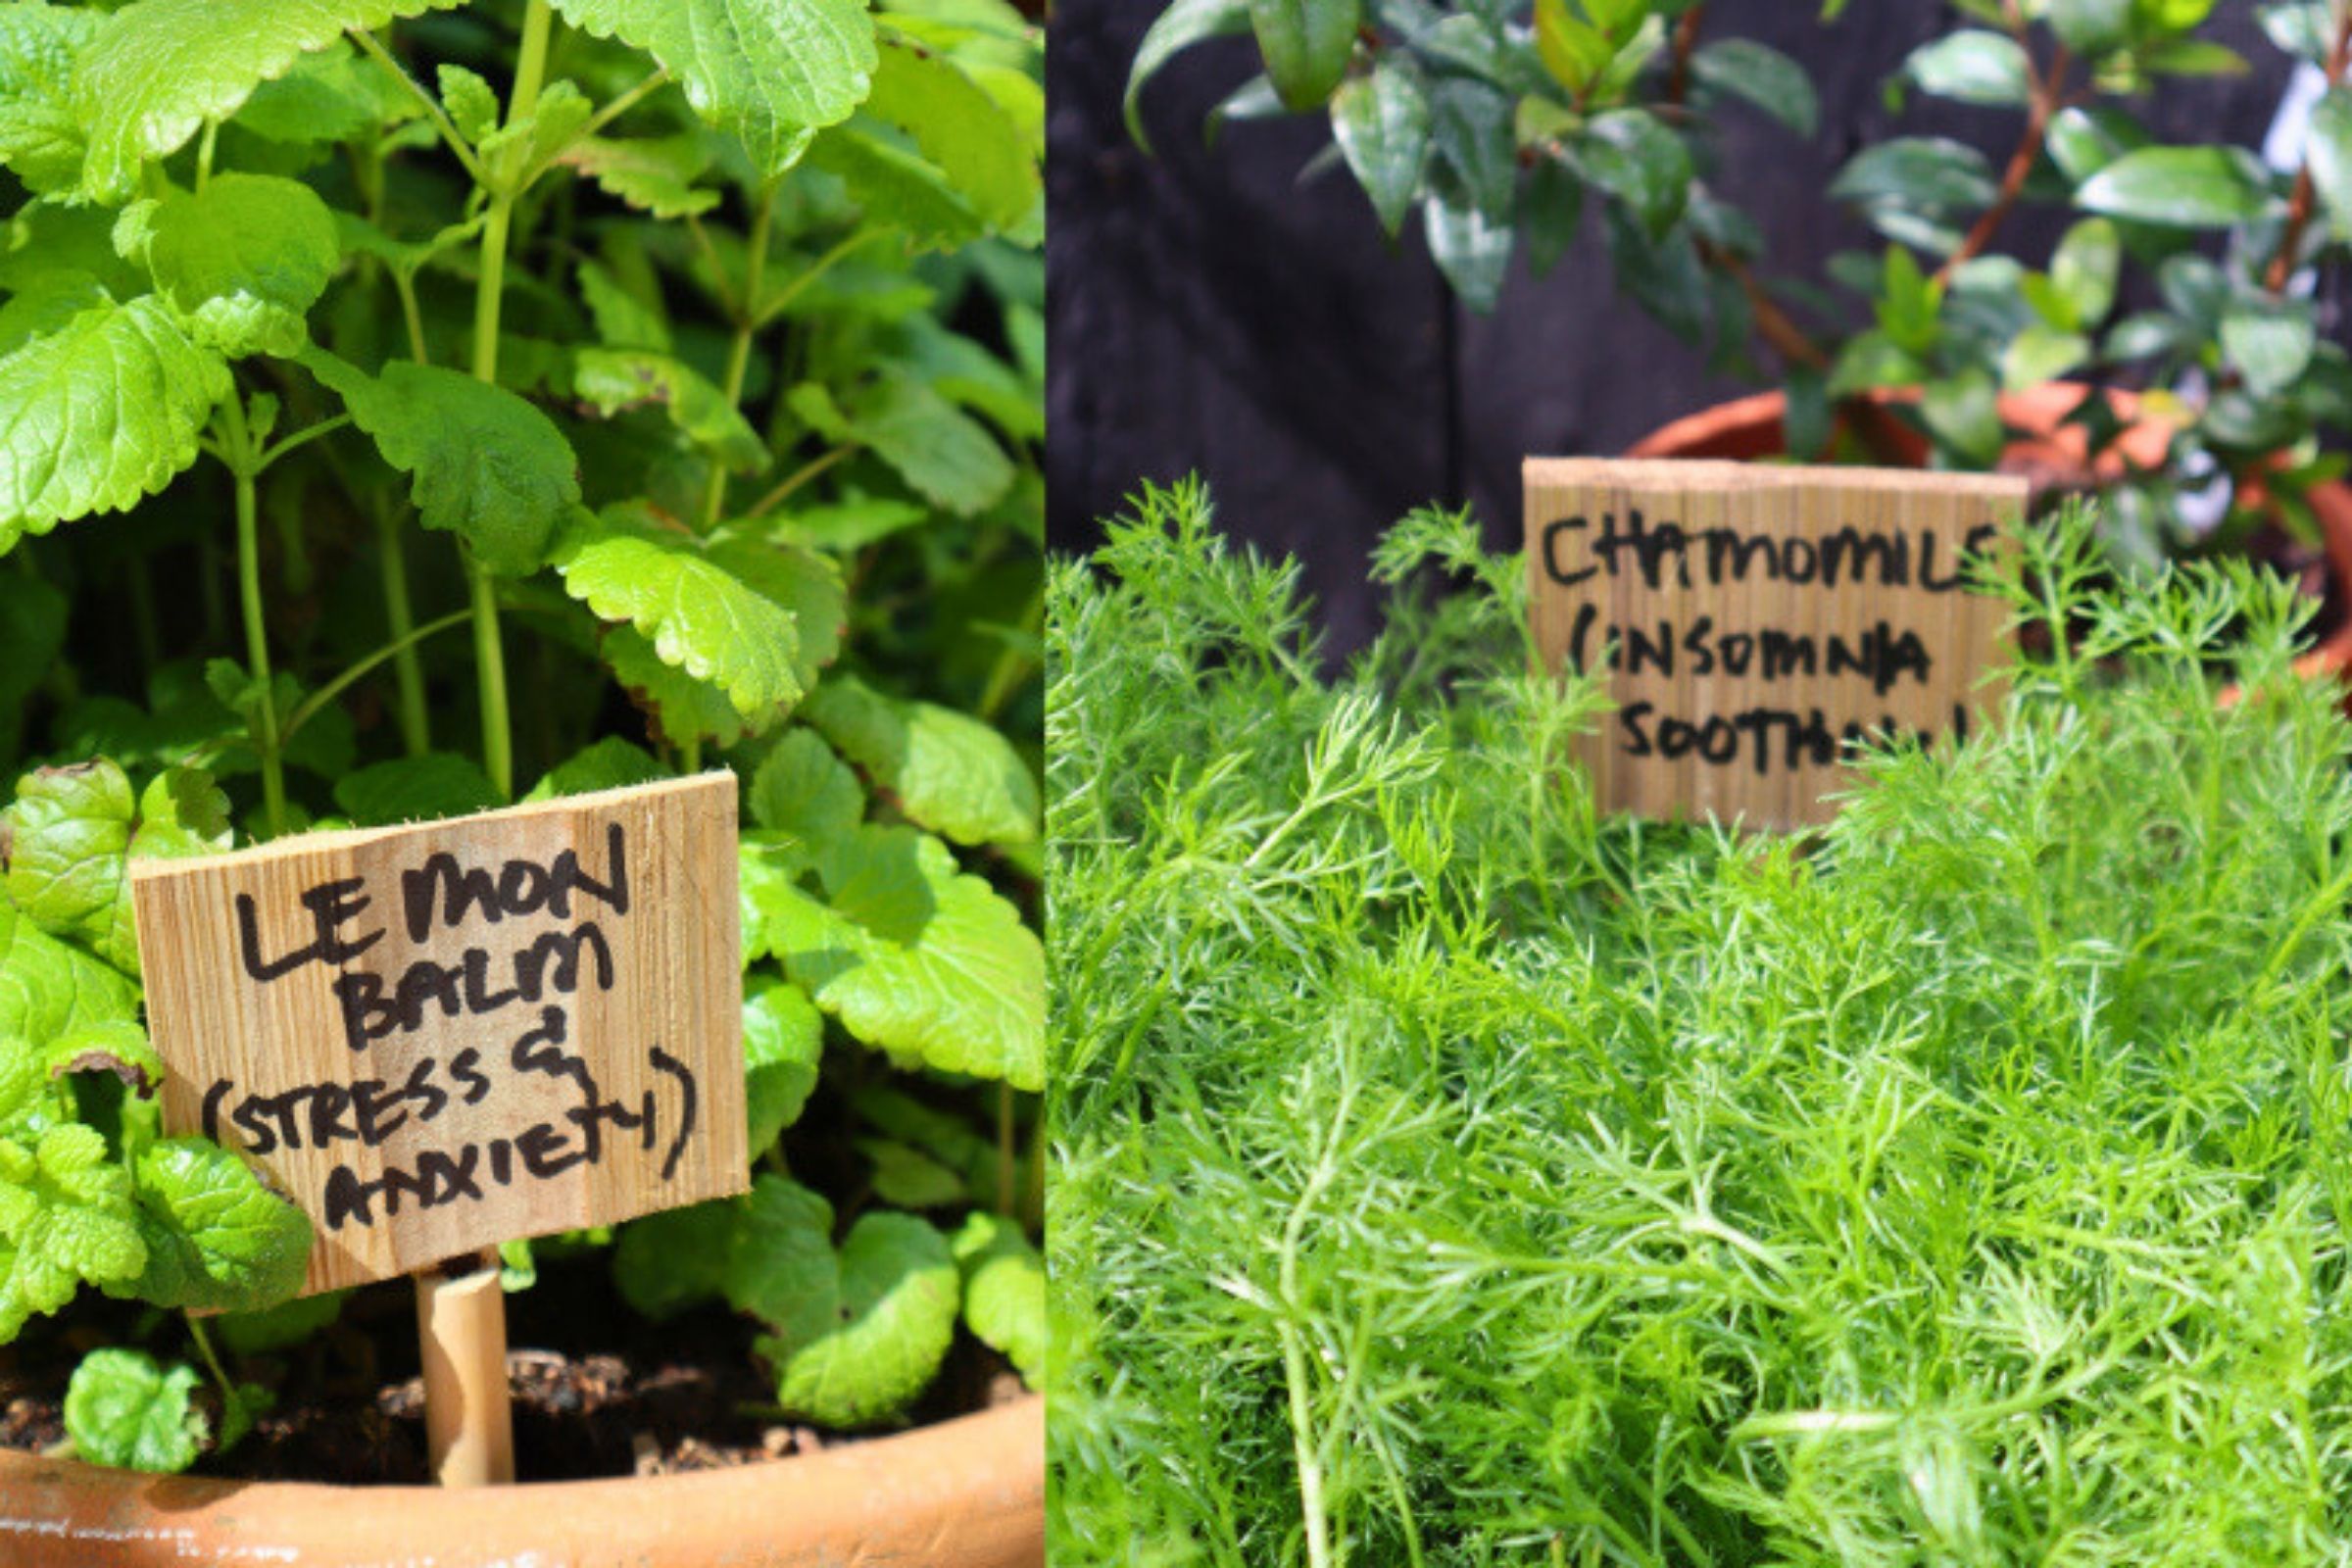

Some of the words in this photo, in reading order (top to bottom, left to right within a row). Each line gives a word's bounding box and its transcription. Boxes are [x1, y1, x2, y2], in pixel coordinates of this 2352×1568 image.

[236, 822, 628, 981] LEMON
[334, 922, 613, 1051] BALM
[201, 1047, 491, 1156] (STRESS
[512, 1004, 588, 1090] &
[322, 1047, 697, 1231] ANXIETY)
